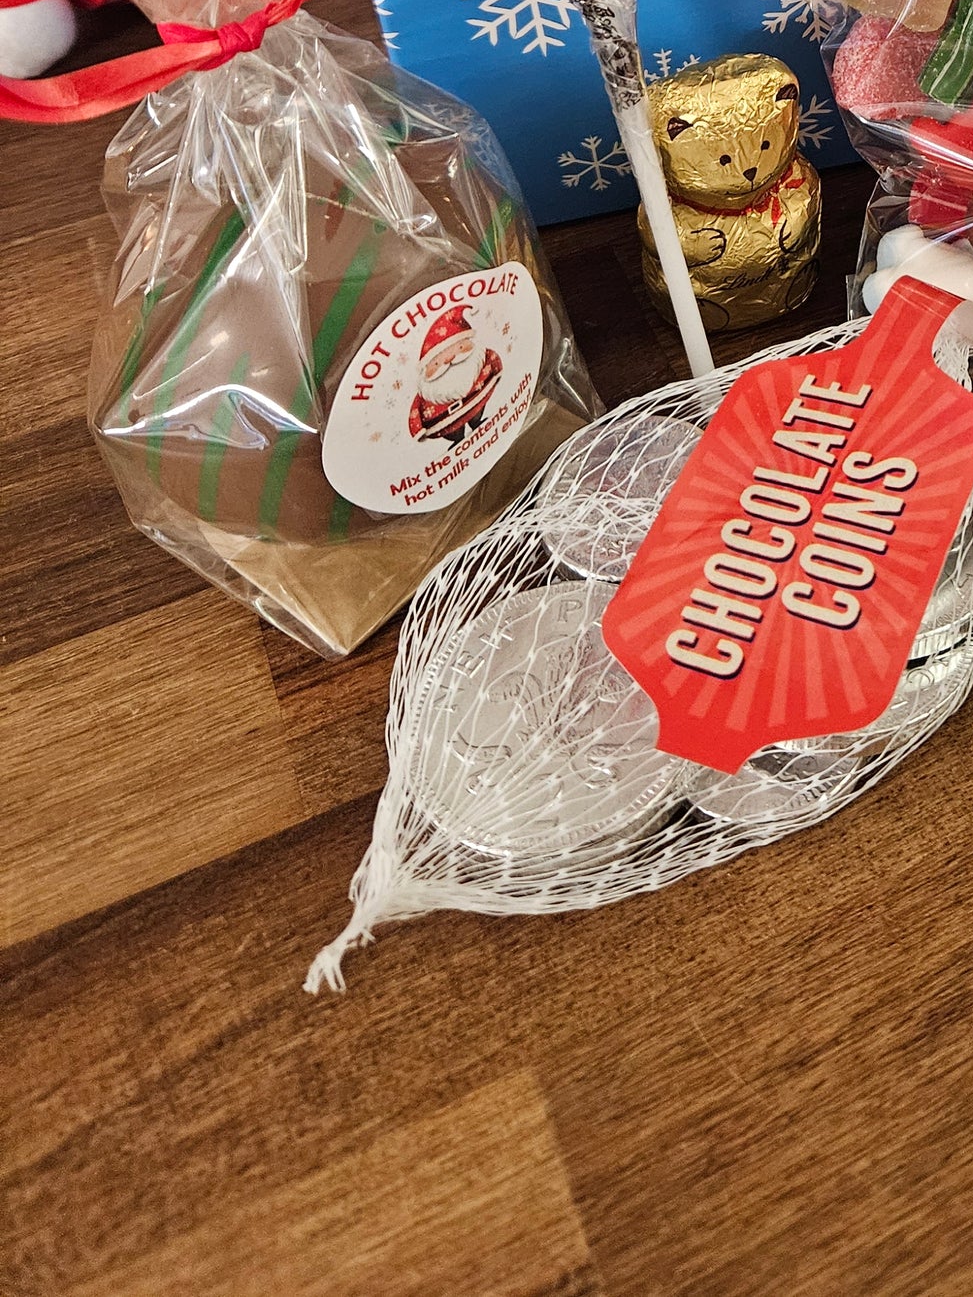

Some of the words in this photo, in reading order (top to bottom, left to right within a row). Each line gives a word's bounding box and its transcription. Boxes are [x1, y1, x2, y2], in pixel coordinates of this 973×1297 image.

[351, 340, 391, 402] HOT
[391, 272, 519, 339] CHOCOLATE
[389, 475, 422, 496] Mix
[424, 456, 452, 478] the
[455, 405, 509, 457] contents
[510, 373, 533, 404] with
[404, 484, 435, 506] hot
[438, 457, 470, 489] milk
[473, 430, 500, 460] and
[501, 388, 533, 434] enjoy!
[665, 373, 872, 680] CHOCOLATE
[781, 450, 919, 631] COINS
